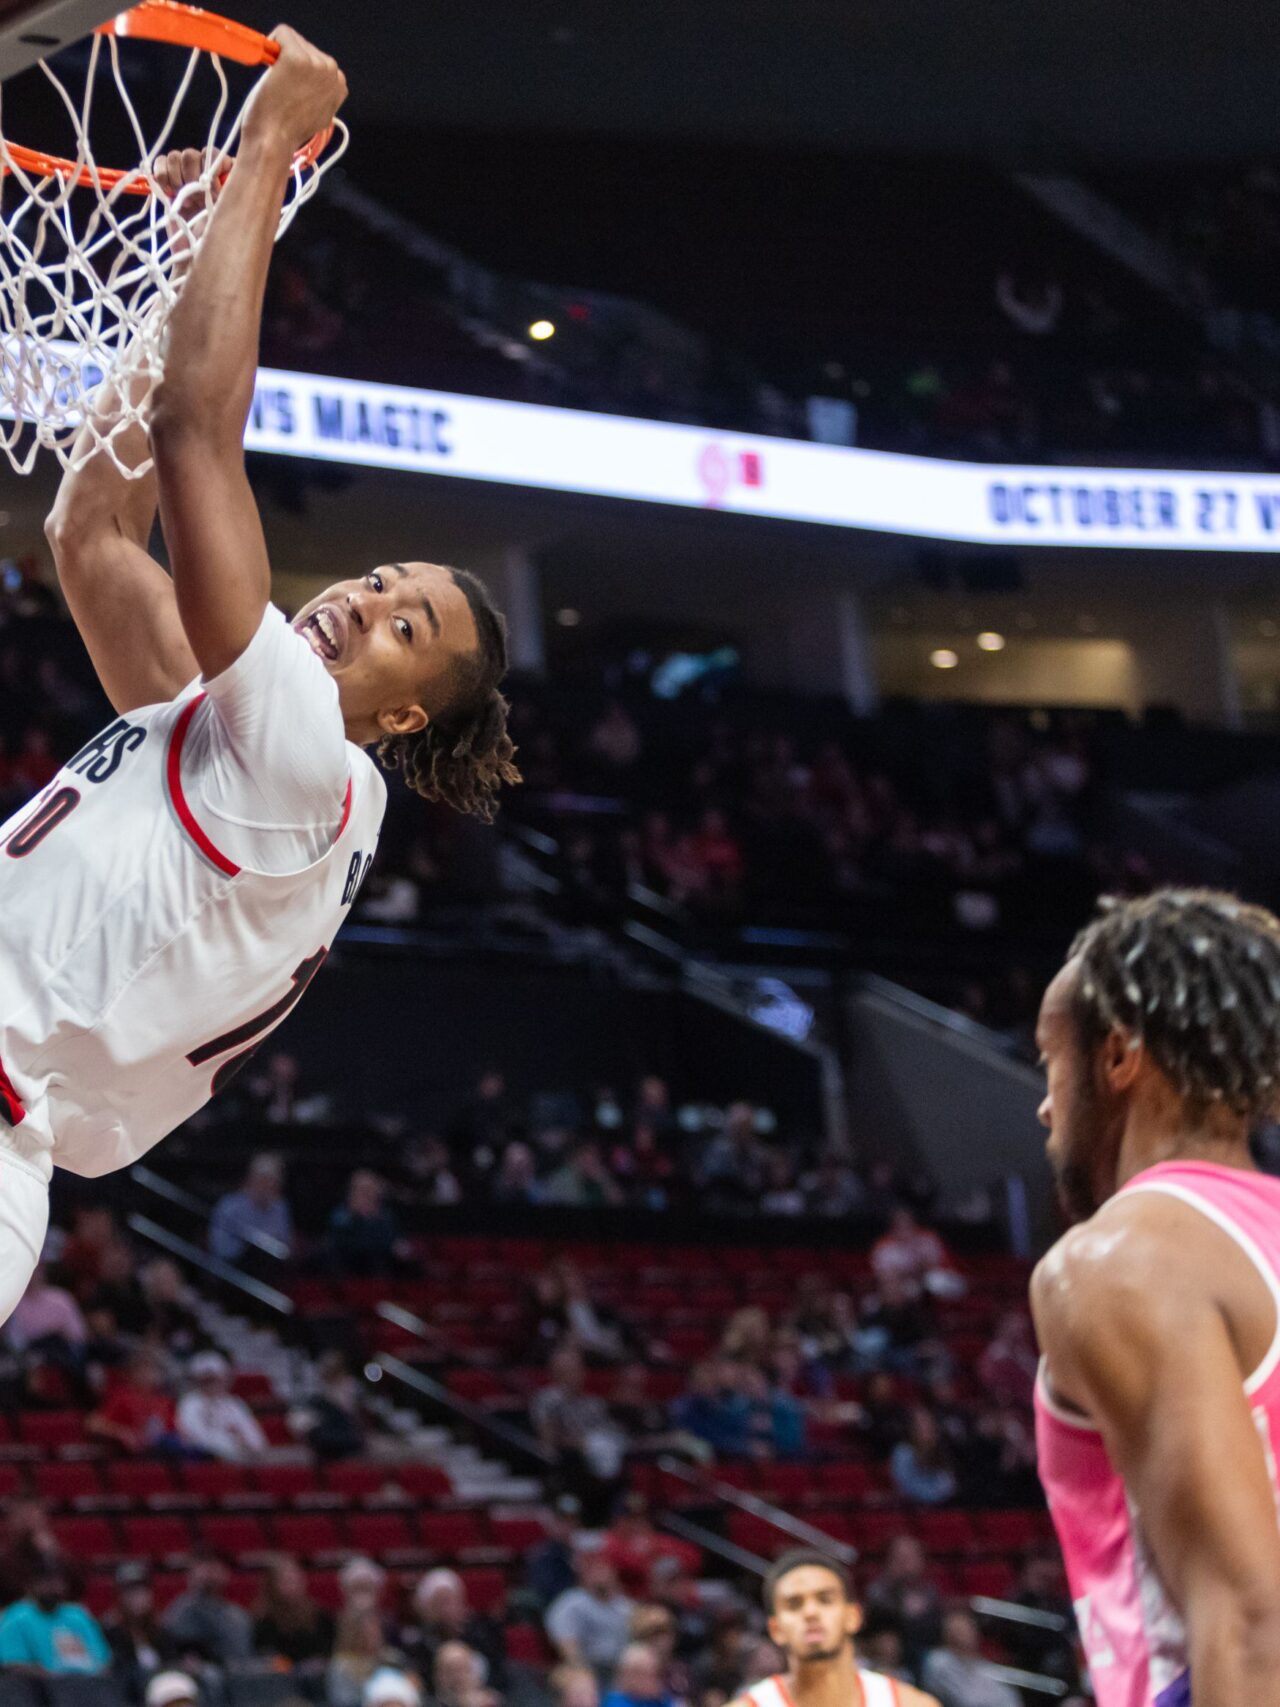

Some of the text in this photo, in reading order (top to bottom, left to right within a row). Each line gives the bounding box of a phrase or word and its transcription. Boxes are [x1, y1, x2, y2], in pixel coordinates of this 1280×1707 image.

[313, 394, 451, 453] MAGIC
[989, 484, 1176, 528] OCTOBER
[1197, 490, 1236, 532] 27
